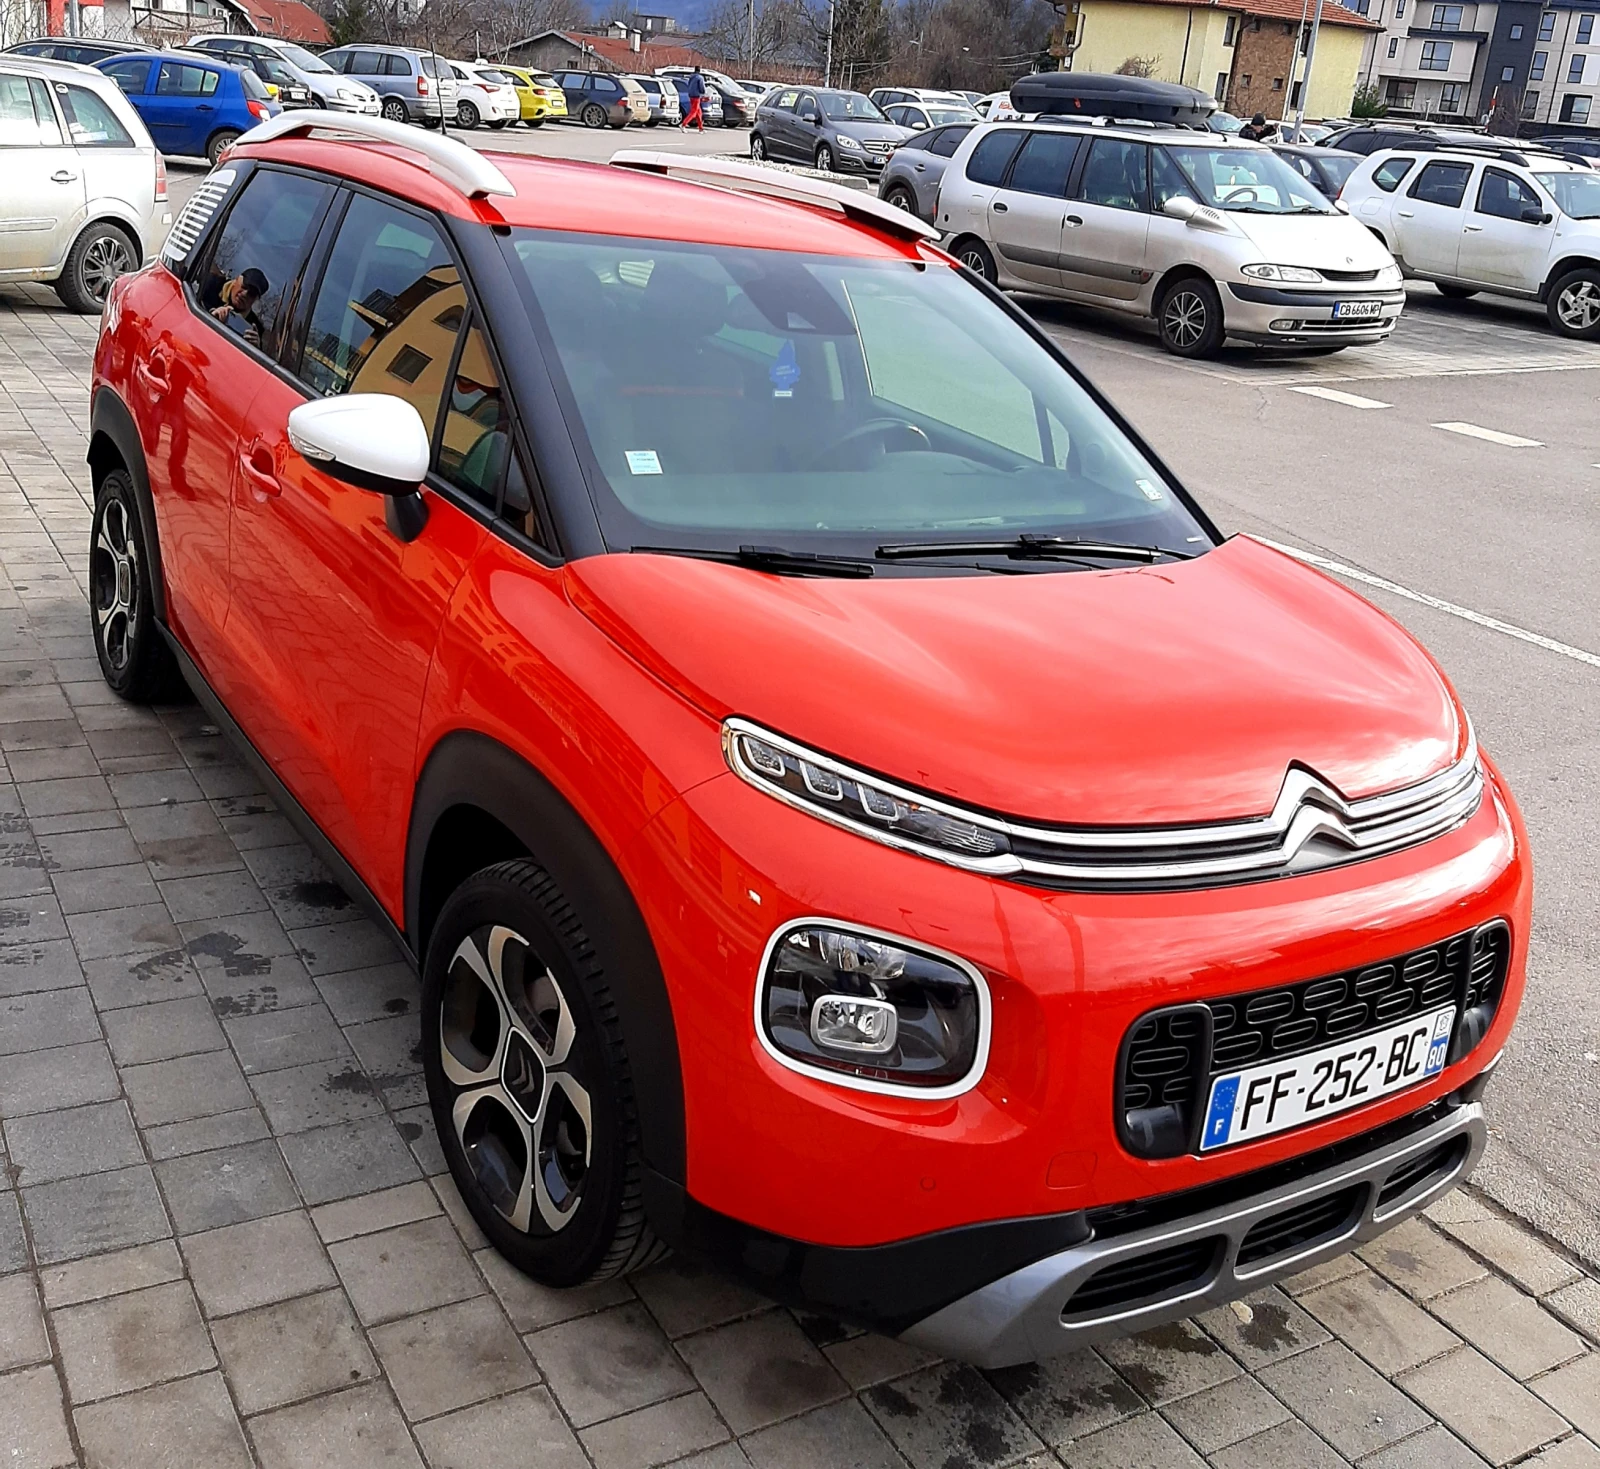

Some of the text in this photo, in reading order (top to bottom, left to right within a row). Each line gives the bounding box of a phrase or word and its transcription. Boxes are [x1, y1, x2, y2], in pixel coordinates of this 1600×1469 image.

[1340, 304, 1351, 315] CB
[1351, 304, 1369, 315] 6606
[1428, 1042, 1446, 1067] 80
[1240, 1027, 1428, 1131] FF-252-BC
[1214, 1119, 1225, 1135] F
